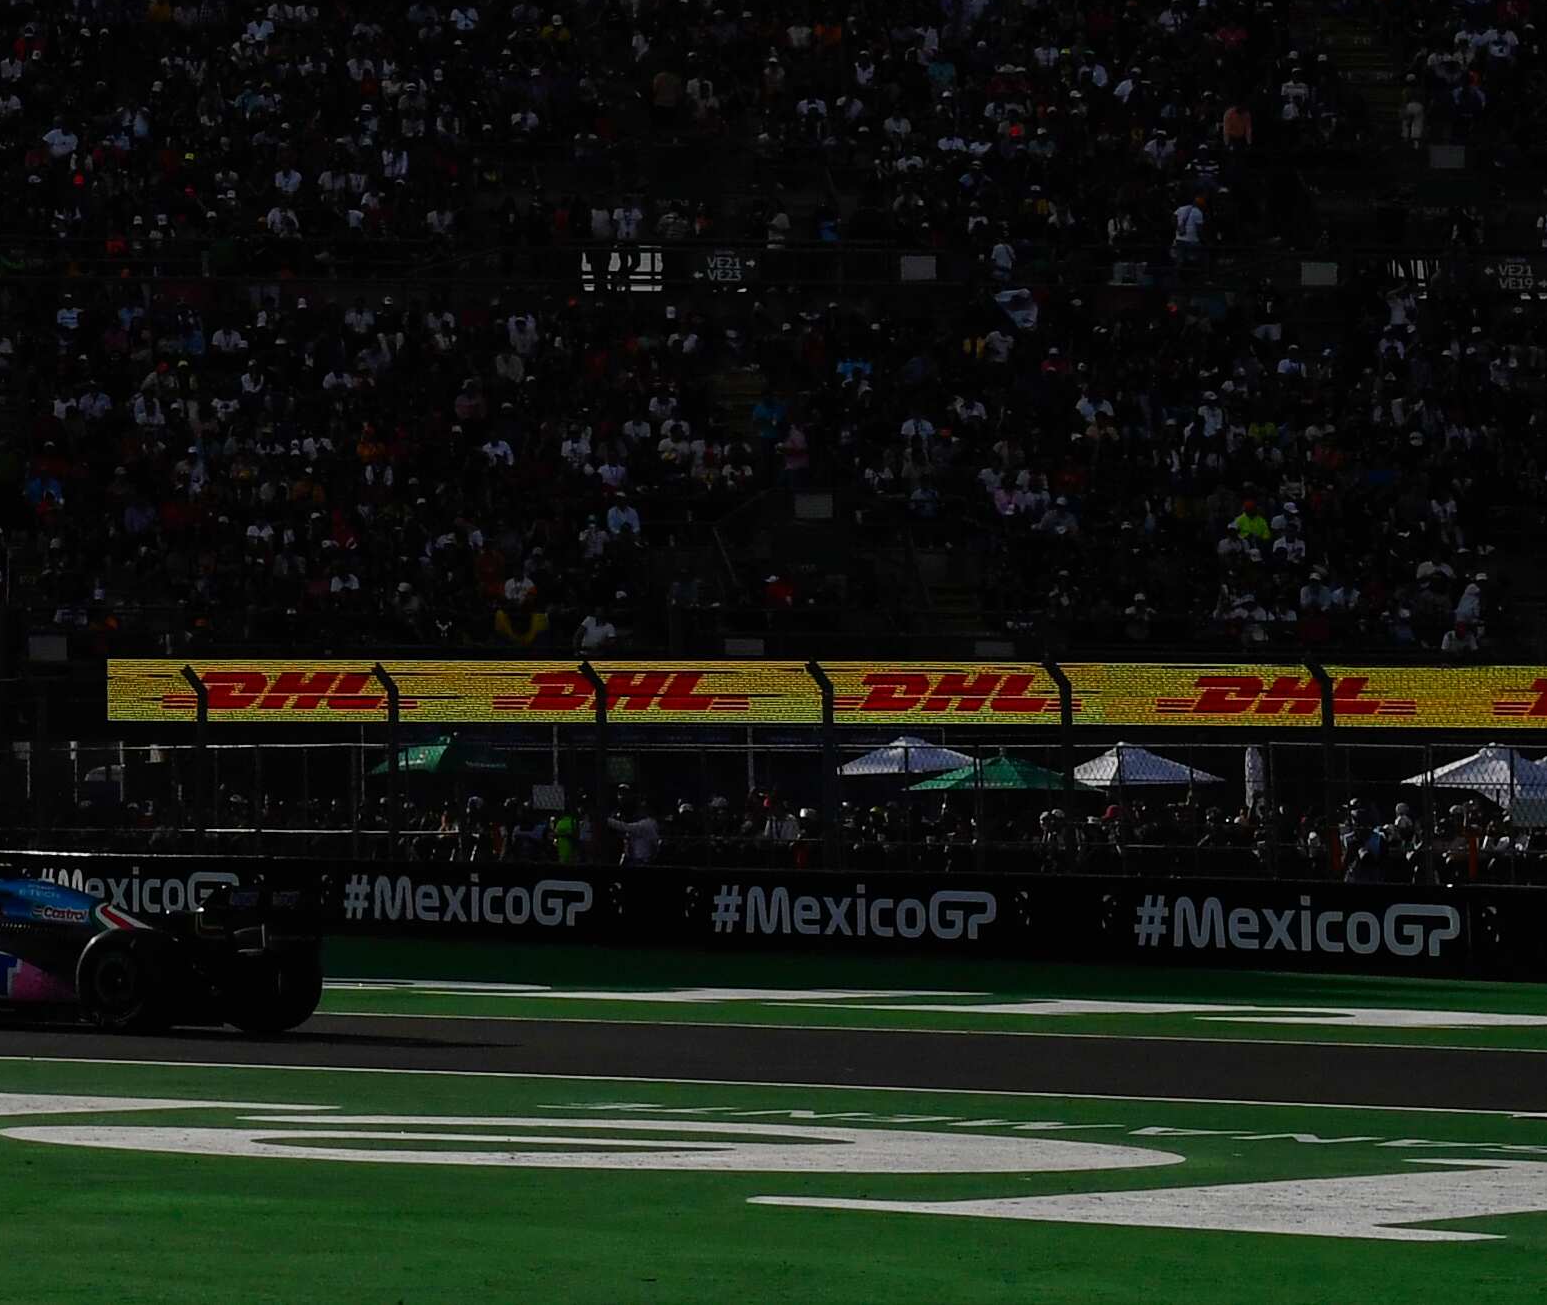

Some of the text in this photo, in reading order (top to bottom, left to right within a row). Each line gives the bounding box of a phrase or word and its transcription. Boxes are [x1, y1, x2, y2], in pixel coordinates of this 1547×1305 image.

[201, 674, 385, 710] DHL
[529, 673, 713, 710] DHL
[861, 674, 1048, 712] DHL
[1193, 677, 1380, 715] DHL
[41, 906, 88, 923] Castrol
[343, 873, 594, 926] #MexicoGP
[711, 883, 998, 940] #MexicoGP
[1133, 895, 1462, 957] #MexicoGP
